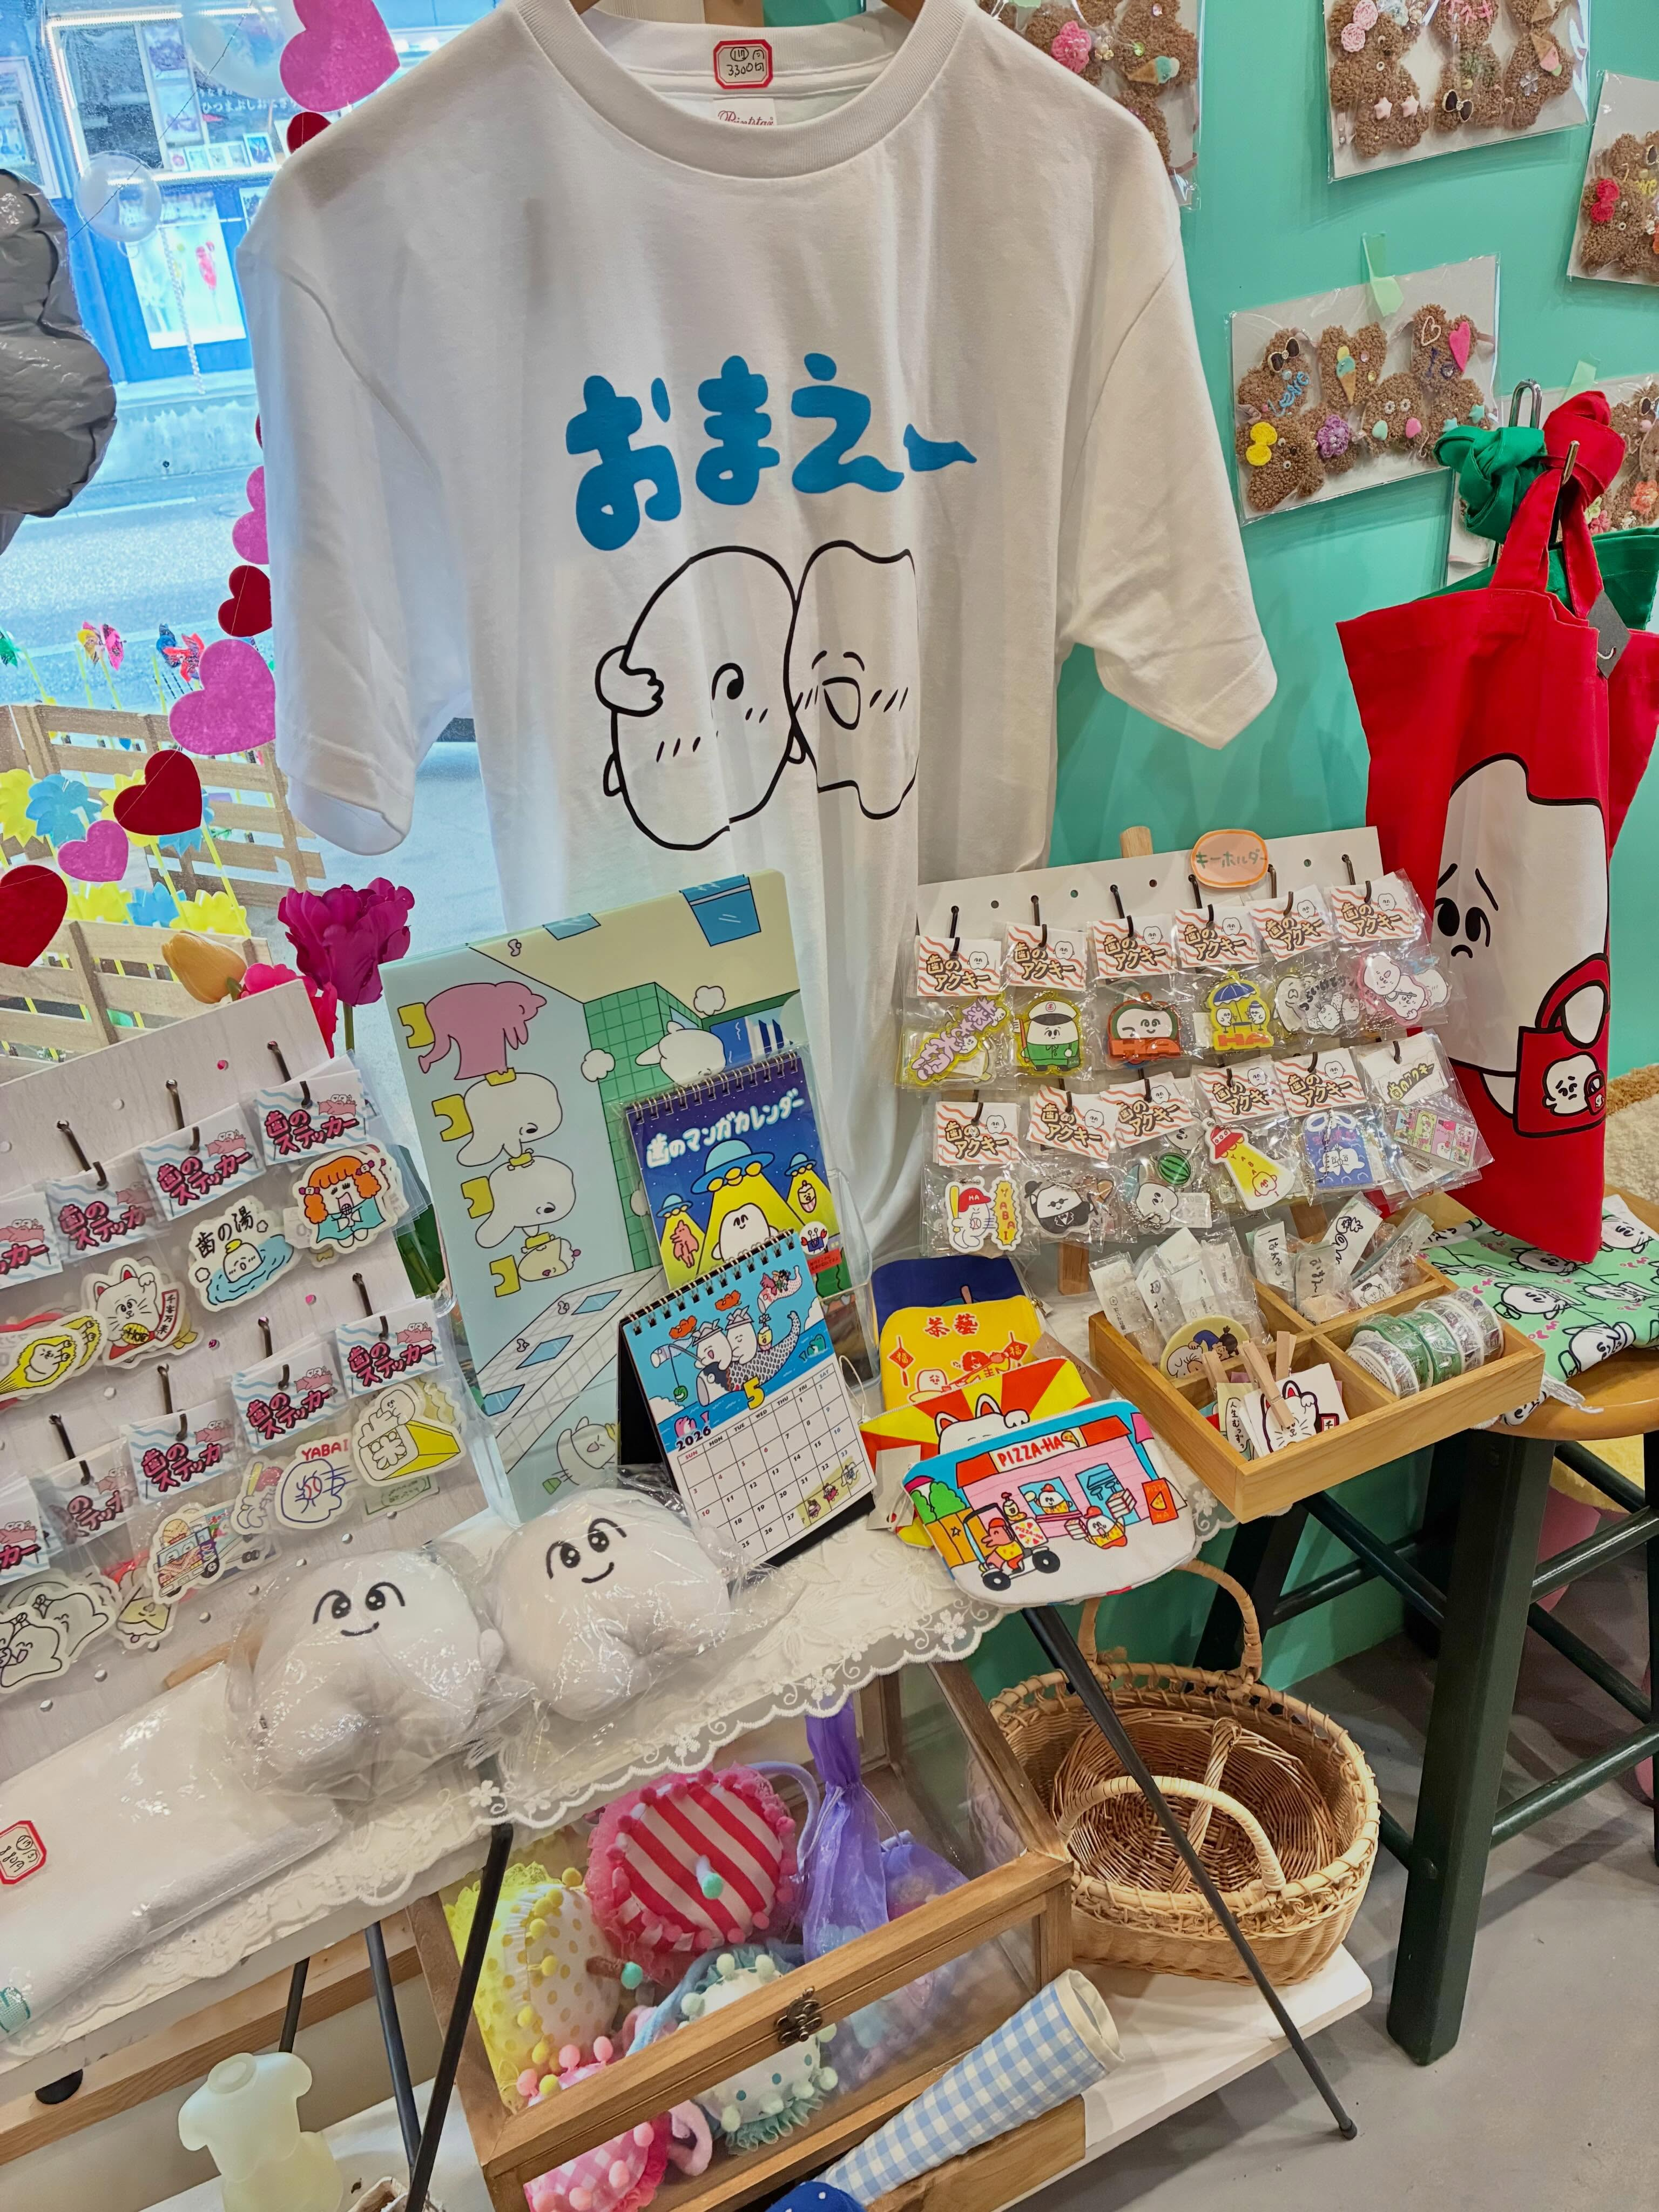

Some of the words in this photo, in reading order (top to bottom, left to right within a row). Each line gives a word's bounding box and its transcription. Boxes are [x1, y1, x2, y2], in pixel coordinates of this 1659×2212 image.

[1195, 848, 1267, 868] キーホルダー
[1341, 902, 1373, 920] 歯の
[1352, 914, 1403, 937] アクキー
[1184, 924, 1217, 946] 歯の
[1265, 917, 1298, 939] 歯の
[1280, 919, 1324, 952] アクキー
[1014, 941, 1048, 963] 歯の
[1103, 934, 1138, 955] 歯の
[1193, 937, 1247, 961] アクキー
[926, 953, 962, 976] 歯の
[1022, 960, 1076, 981] アクキー
[1114, 947, 1166, 972] アクキー
[935, 972, 992, 992] アクキー
[1111, 1038, 1181, 1055] HA
[1218, 1033, 1271, 1047] HA
[1287, 1074, 1323, 1095] 歯の
[1300, 1081, 1353, 1108] アクキー
[1387, 1062, 1435, 1101] 歯のアクキー
[265, 1109, 312, 1138] 歯の
[646, 1087, 805, 1169] 歯のマンガカレンダー
[945, 1120, 981, 1142] 歯の
[1129, 1104, 1181, 1137] アクキー
[274, 1116, 360, 1155] ステッカー
[954, 1136, 1009, 1159] アクキー
[1045, 1123, 1103, 1148] アクキー
[157, 1156, 203, 1193] 歯の
[170, 1151, 253, 1206] ステッカー
[58, 1200, 109, 1235] 歯の
[1000, 1188, 1016, 1241] YABAI
[195, 1205, 254, 1259] 歯の湯
[347, 1341, 390, 1372] 歯の
[357, 1344, 436, 1387] ステッカー
[743, 1375, 765, 1411] 5
[246, 1392, 291, 1427] 歯の
[258, 1387, 339, 1440] ステッカー
[685, 1450, 698, 1460] SUN
[709, 1435, 723, 1447] MON
[734, 1422, 745, 1432] TUE
[755, 1409, 767, 1419] WED
[777, 1395, 788, 1406] THU
[798, 1384, 807, 1393] FRI
[819, 1369, 830, 1379] SAT
[302, 1438, 350, 1461] YABAI
[676, 1425, 712, 1452] 2026
[996, 1434, 1064, 1468] PIZZA-HA
[141, 1442, 189, 1477] 歯の
[702, 1509, 710, 1517] 10
[726, 1495, 734, 1503] 11
[814, 1440, 821, 1448] 15
[834, 1427, 841, 1435] 16
[734, 1518, 743, 1526] 18
[757, 1504, 765, 1512] 19
[779, 1491, 787, 1499] 20
[800, 1476, 808, 1485] 21
[821, 1463, 830, 1471] 22
[840, 1449, 848, 1458] 23
[741, 1540, 750, 1548] 25
[786, 1513, 794, 1521] 27
